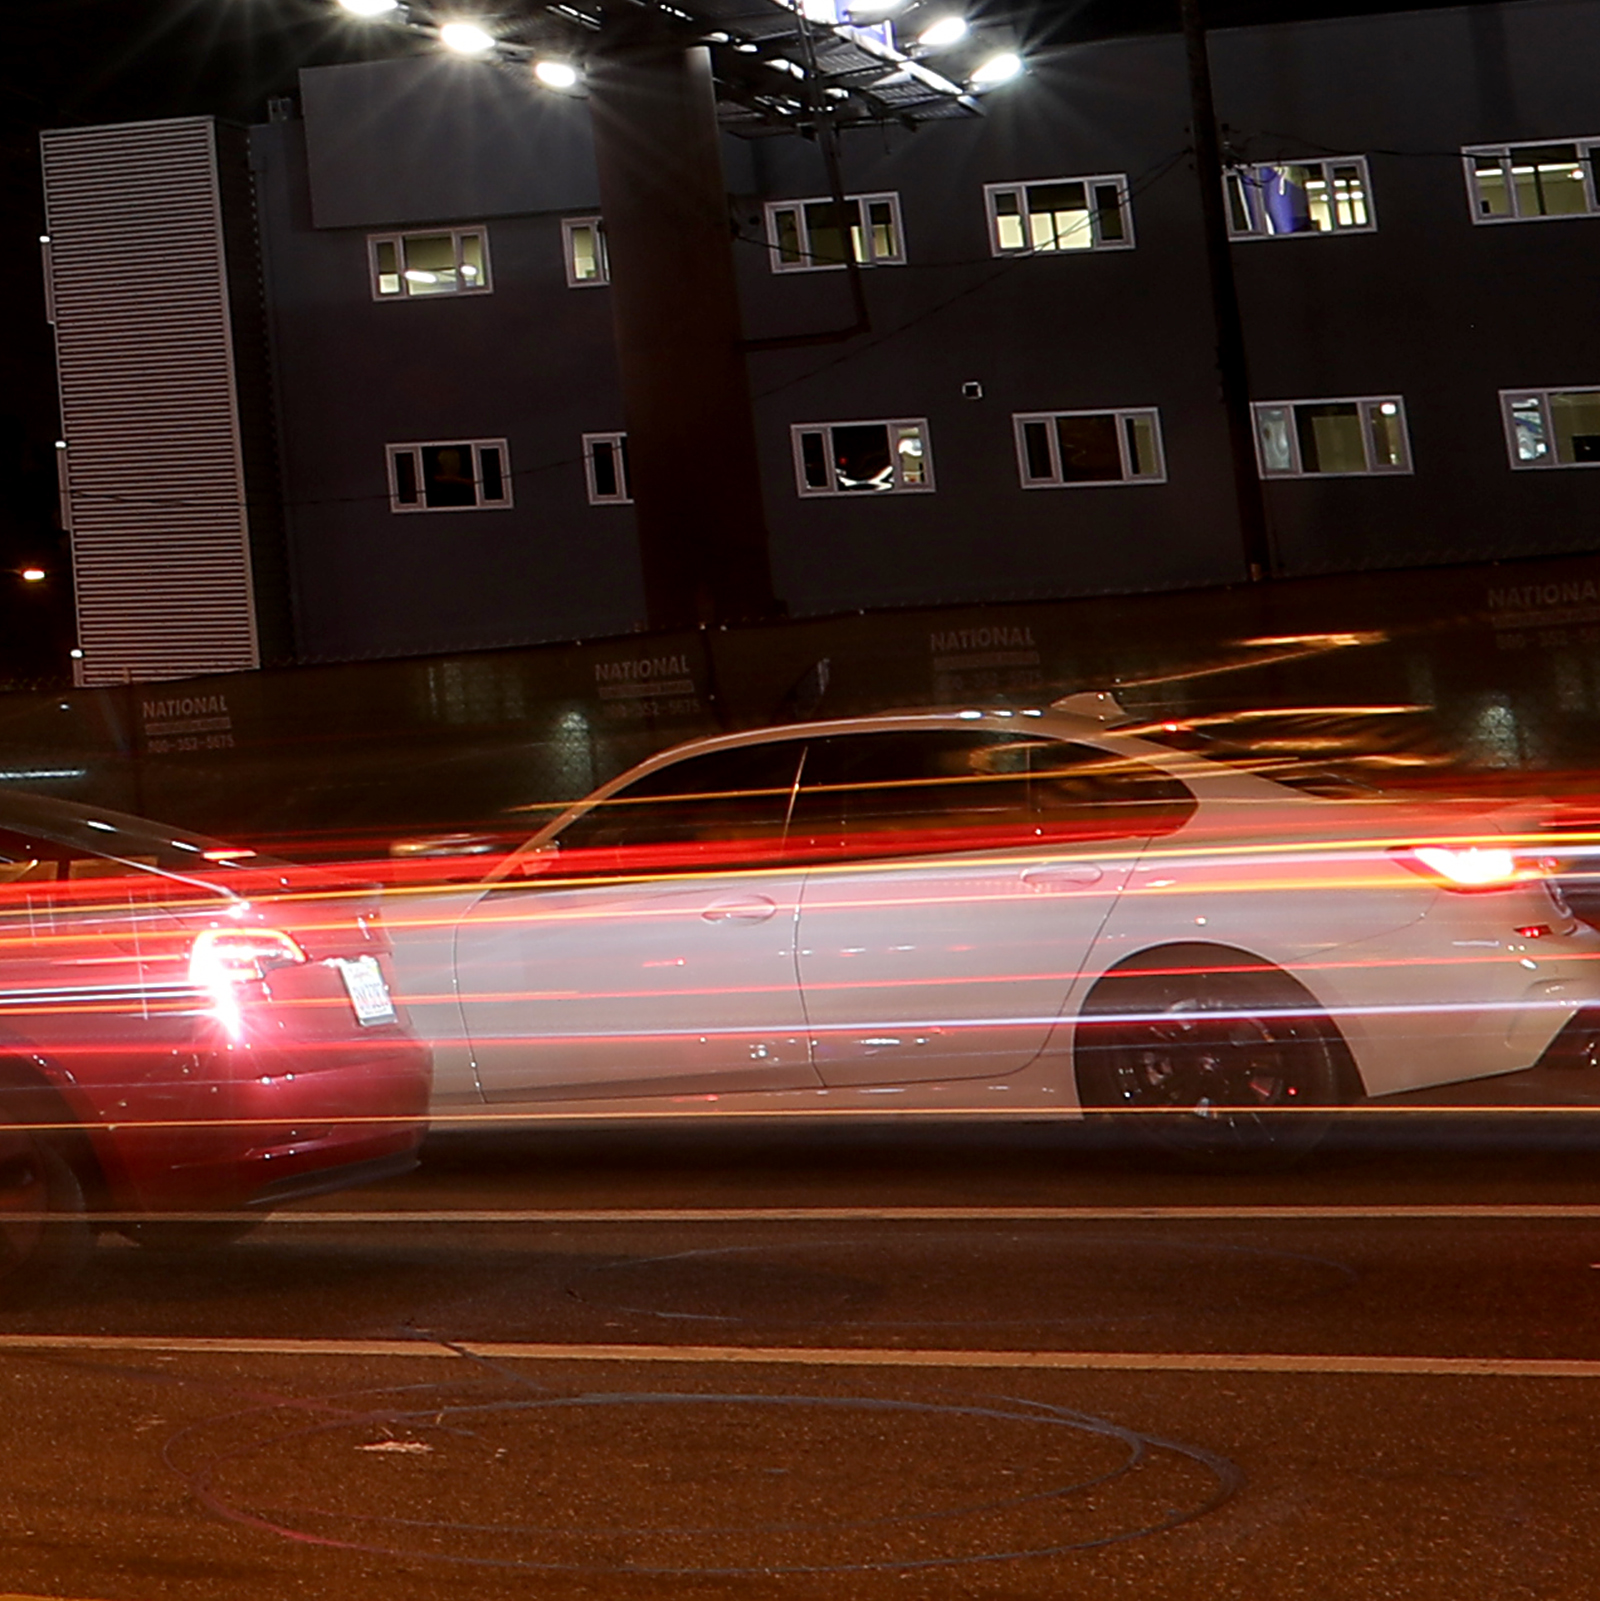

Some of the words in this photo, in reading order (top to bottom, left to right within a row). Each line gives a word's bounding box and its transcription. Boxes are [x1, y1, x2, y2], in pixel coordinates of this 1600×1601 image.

[1487, 579, 1600, 608] NATIONA
[930, 626, 1036, 653] NATIONAL
[594, 654, 691, 681] NATIONAL
[142, 694, 229, 718] NATIONAL
